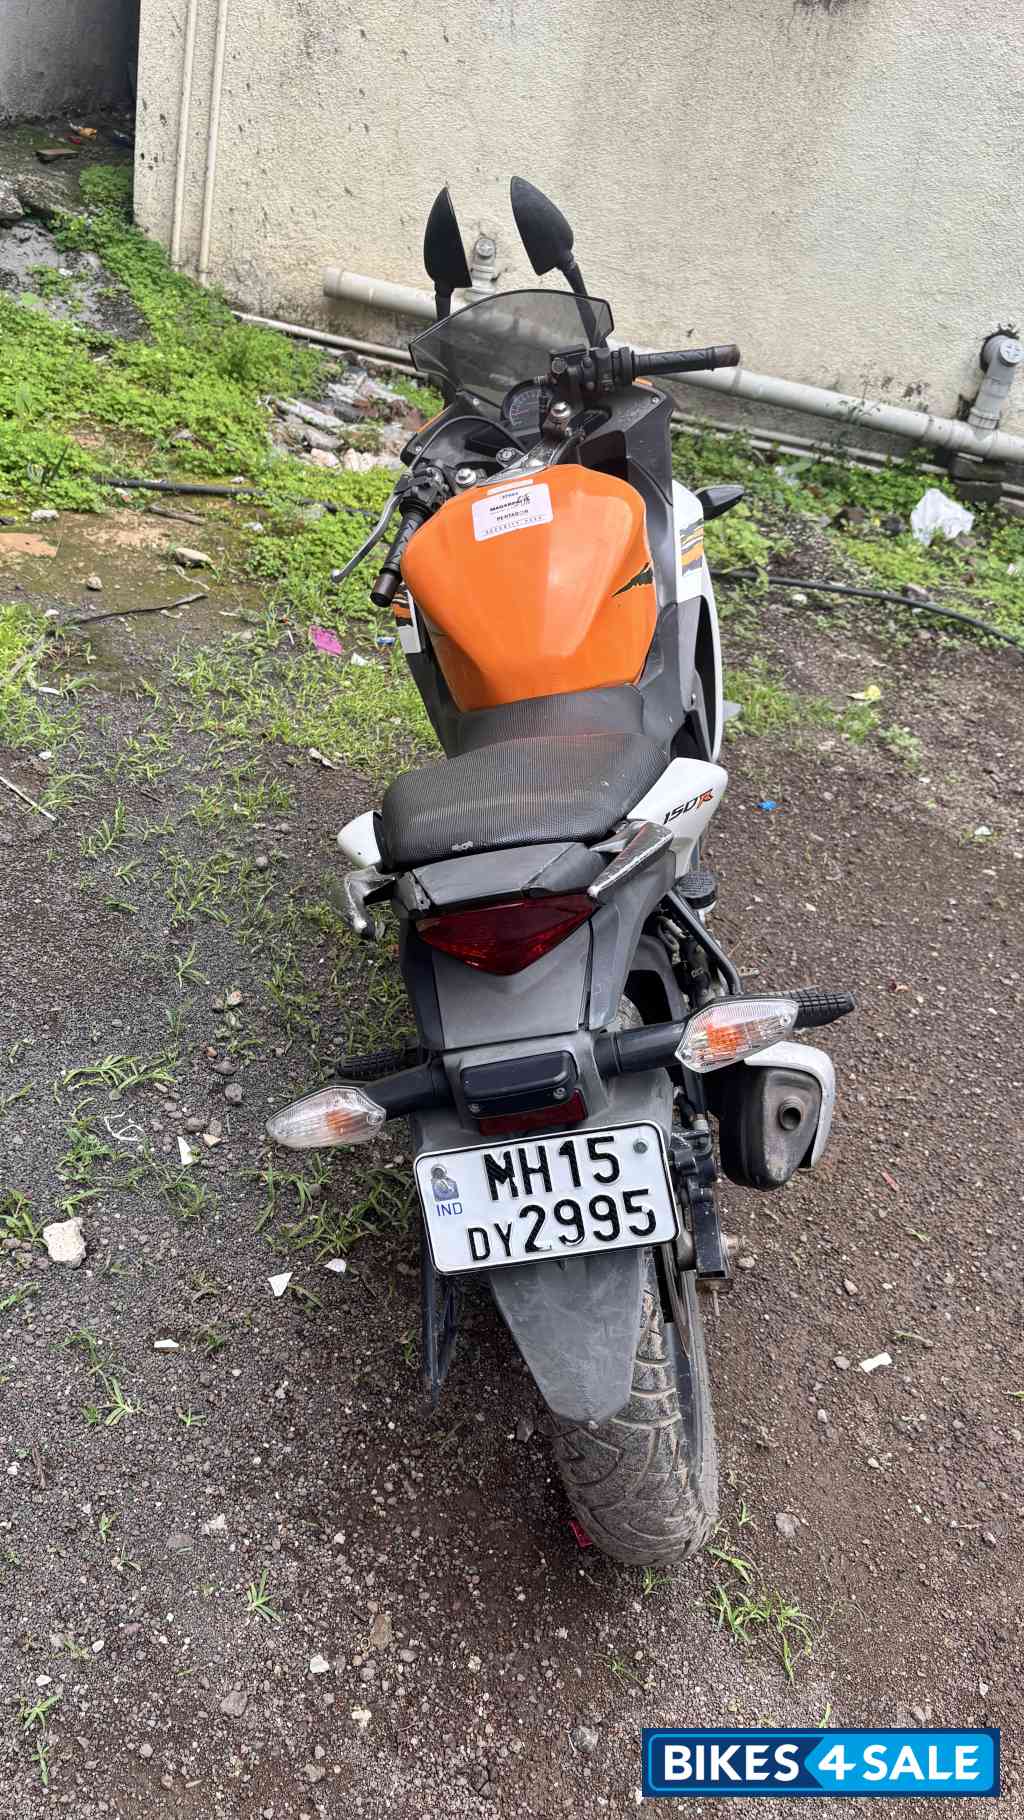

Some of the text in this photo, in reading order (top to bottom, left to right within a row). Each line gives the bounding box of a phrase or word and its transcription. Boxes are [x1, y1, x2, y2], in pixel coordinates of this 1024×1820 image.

[483, 1135, 620, 1201] MH15
[435, 1201, 463, 1217] IND
[466, 1187, 657, 1262] DY2995
